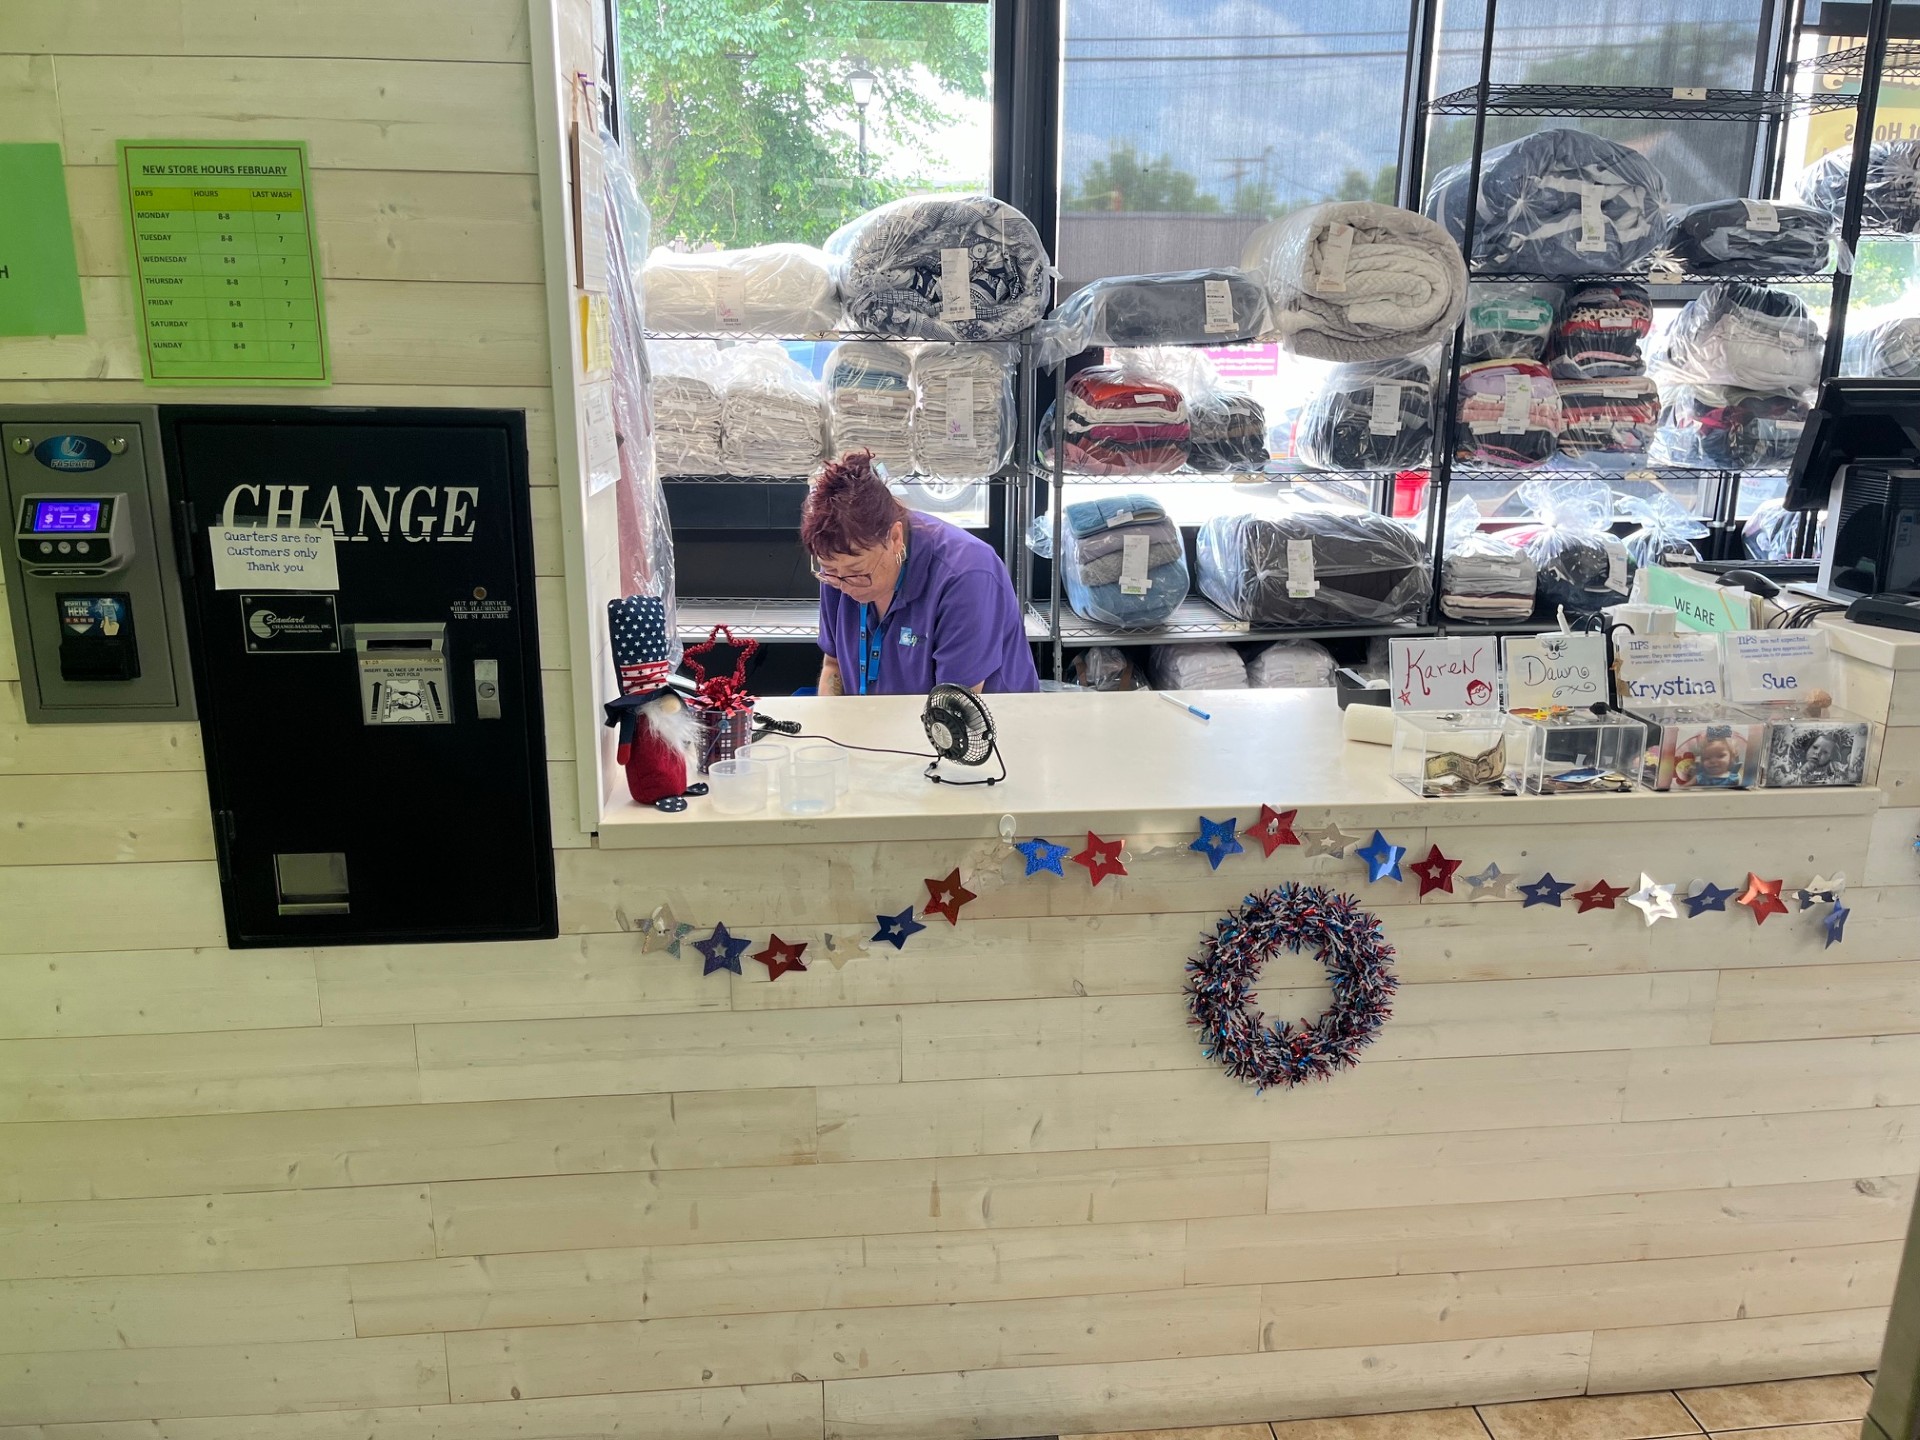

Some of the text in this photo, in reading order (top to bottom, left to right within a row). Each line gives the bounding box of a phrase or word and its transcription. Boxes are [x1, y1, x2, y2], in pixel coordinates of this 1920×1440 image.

[142, 165, 287, 175] NEW STORE HOURS FEBRUARY
[222, 484, 479, 542] CHANGE
[224, 531, 321, 544] Quarters are for
[227, 546, 317, 560] Customers only
[246, 561, 304, 574] Thank you
[68, 606, 90, 616] HERE
[1674, 596, 1715, 627] WE ARE
[266, 615, 305, 624] Standard
[1628, 641, 1649, 651] TIPS
[1737, 636, 1757, 645] TIPS
[1522, 656, 1589, 686] Dawn
[1762, 673, 1798, 689] Sue
[1627, 676, 1716, 700] Krystina
